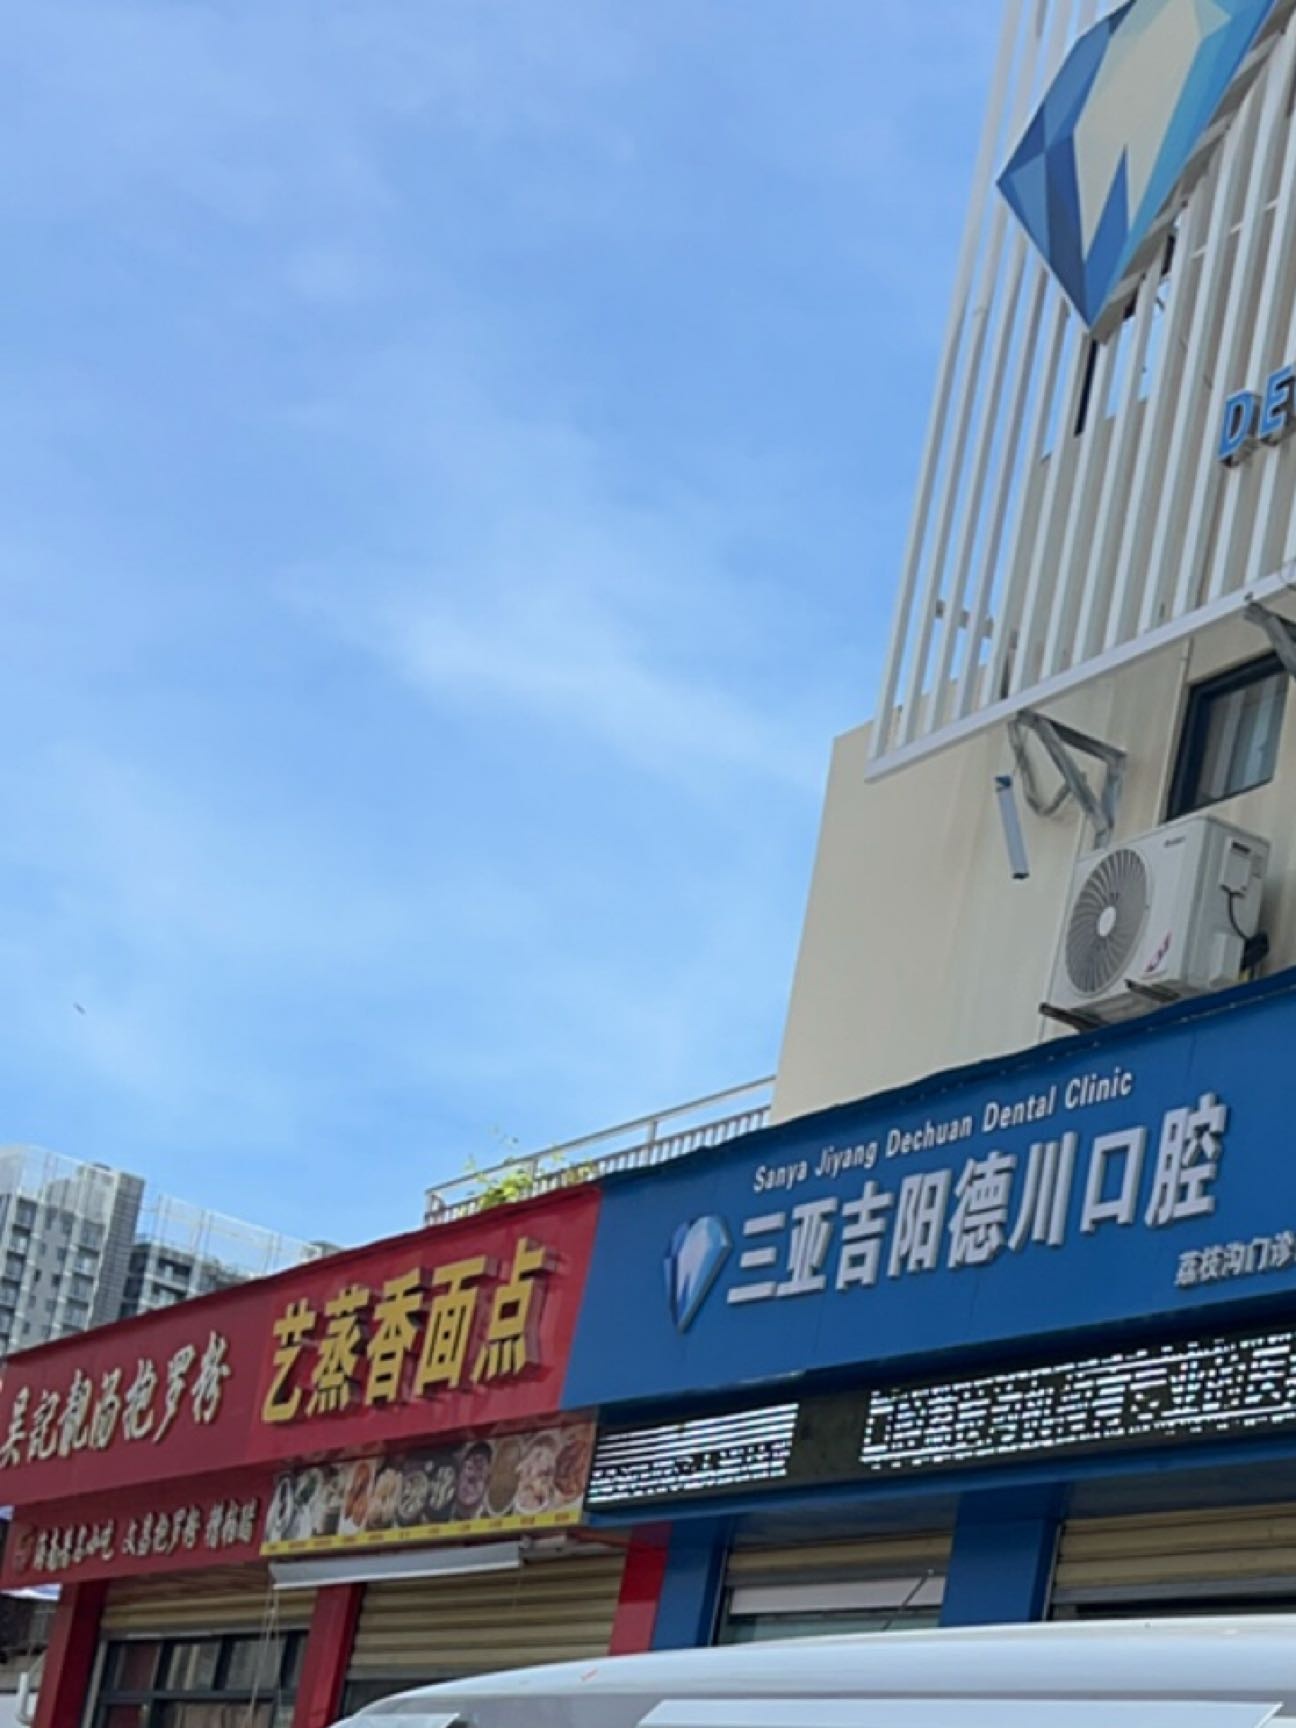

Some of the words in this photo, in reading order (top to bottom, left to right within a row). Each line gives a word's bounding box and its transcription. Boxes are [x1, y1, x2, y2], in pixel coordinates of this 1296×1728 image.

[727, 1091, 1230, 1306] 三亚吉阳德川口腔
[753, 1160, 808, 1193] Sanya
[816, 1141, 877, 1180] Jiyang
[886, 1118, 973, 1158] Dechuan
[984, 1086, 1057, 1132] Dental
[1065, 1067, 1133, 1109] Clinic
[261, 1238, 548, 1423] 艺蒸香面点
